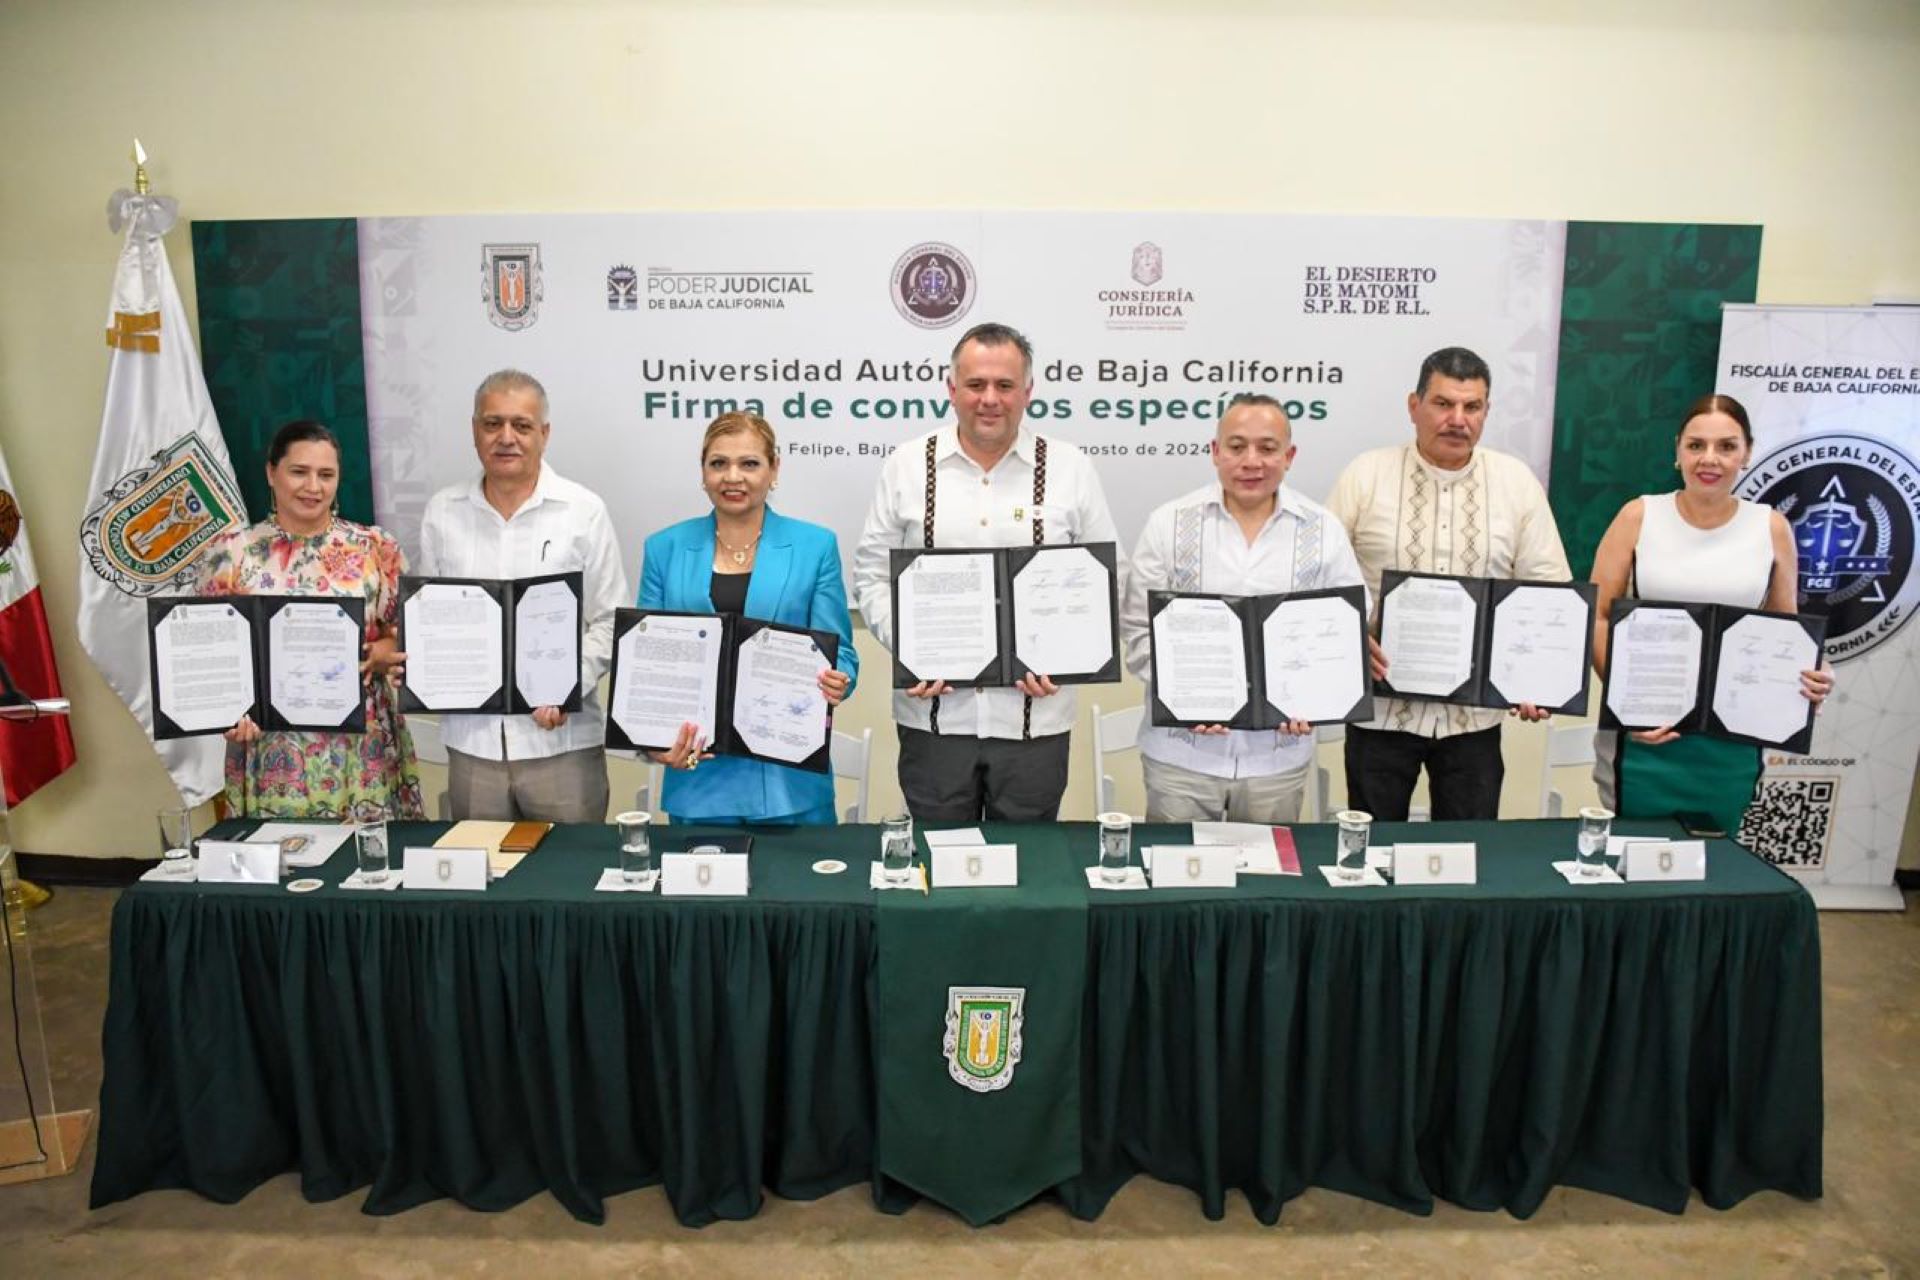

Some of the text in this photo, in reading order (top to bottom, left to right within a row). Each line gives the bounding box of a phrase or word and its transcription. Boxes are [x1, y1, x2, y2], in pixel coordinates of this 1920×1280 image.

[1305, 266, 1437, 283] EL DESIERTO
[648, 277, 814, 294] PODER JUDICIAL
[1304, 283, 1419, 299] DE MATOMI
[1098, 288, 1194, 302] CONSEJERÍA
[648, 299, 785, 310] DE BAJA CALIFORNIA
[1109, 303, 1183, 317] JURÍDICA
[1303, 299, 1430, 315] S.P.R. DE R.L.
[643, 359, 842, 382] Universidad
[1045, 360, 1083, 382] de
[1099, 360, 1168, 388] Baja
[1183, 360, 1343, 384] California
[1731, 363, 1798, 379] FISCALÍA
[1802, 366, 1871, 379] GENERAL
[1875, 368, 1906, 380] DEL
[1768, 381, 1789, 393] DE
[1793, 382, 1832, 394] BAJA
[783, 392, 832, 419] de
[789, 442, 850, 458] Felipe,
[1136, 443, 1157, 455] de
[1165, 443, 1211, 456] 2024
[1777, 446, 1861, 472] GENERAL
[1867, 452, 1899, 475] DEL
[1807, 578, 1833, 588] FGE
